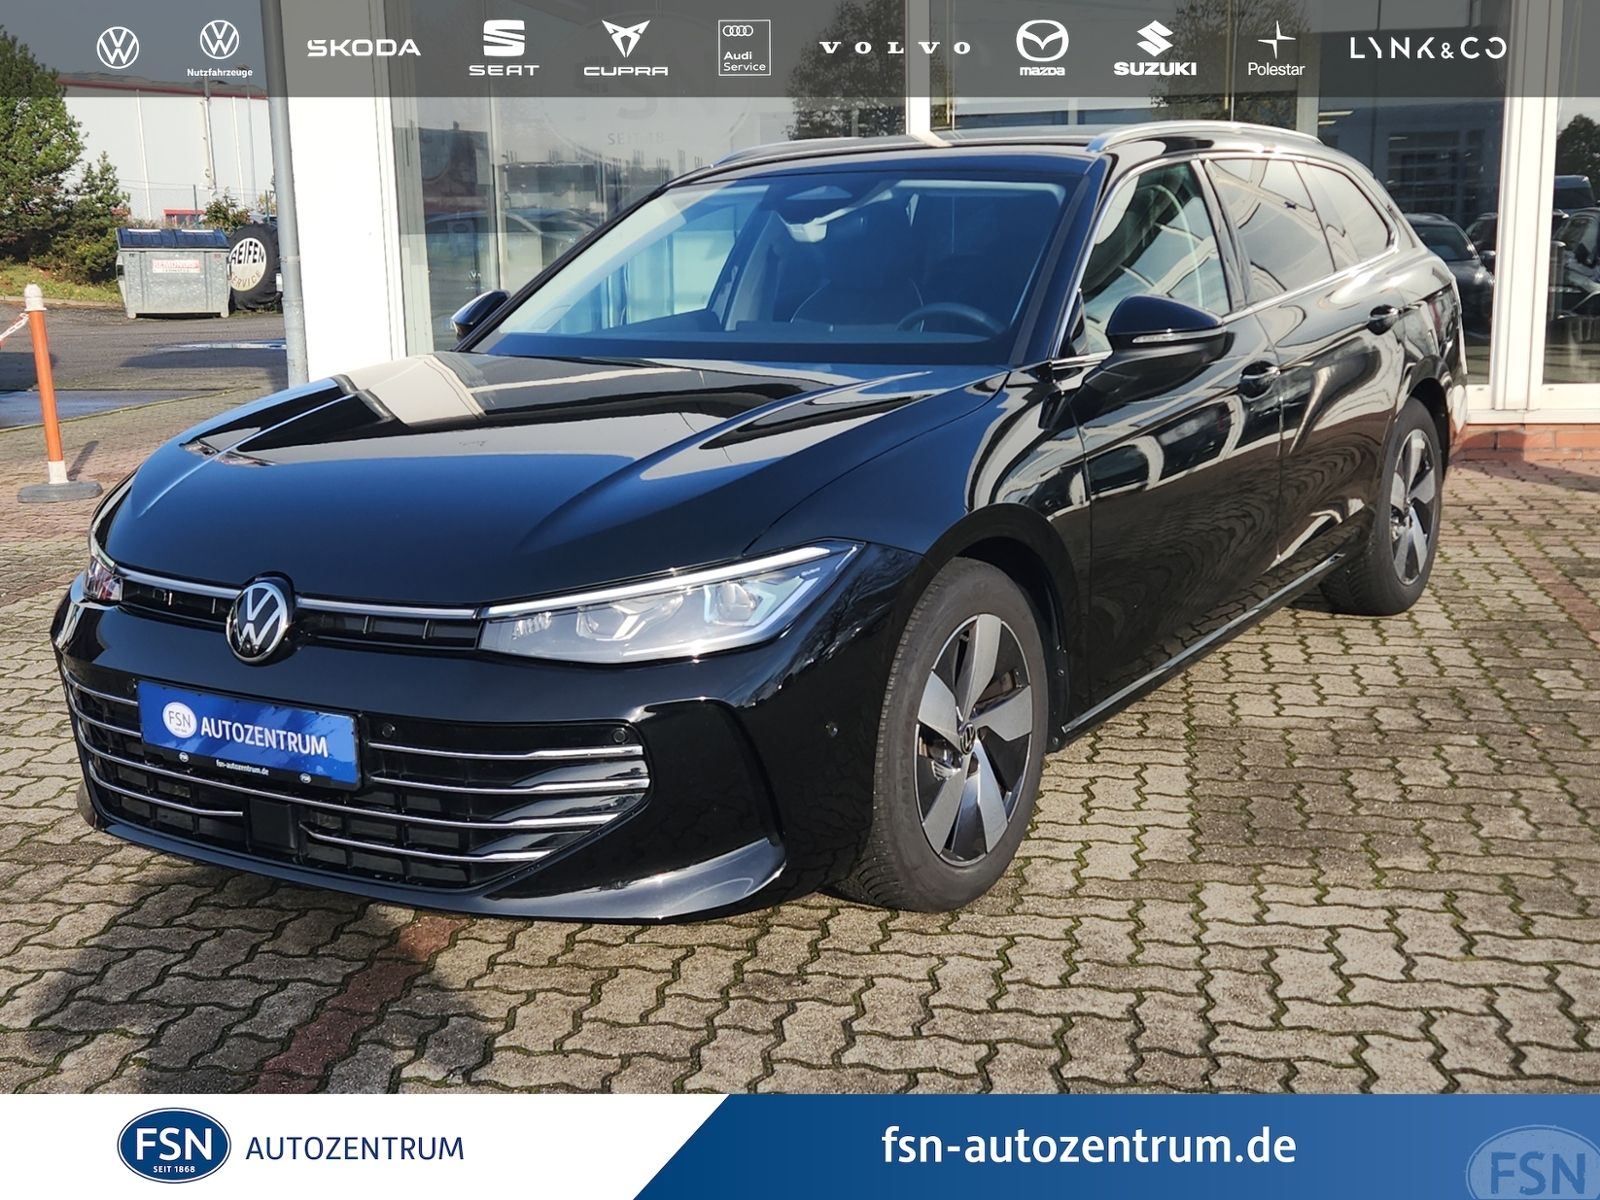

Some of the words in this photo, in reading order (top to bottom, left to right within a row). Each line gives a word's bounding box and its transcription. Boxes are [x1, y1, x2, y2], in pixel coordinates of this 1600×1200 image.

[231, 240, 265, 264] REIFEN
[168, 710, 192, 728] FSN
[201, 716, 328, 758] AUTOZENTRUM
[216, 759, 269, 776] fsn-autozentrum.de
